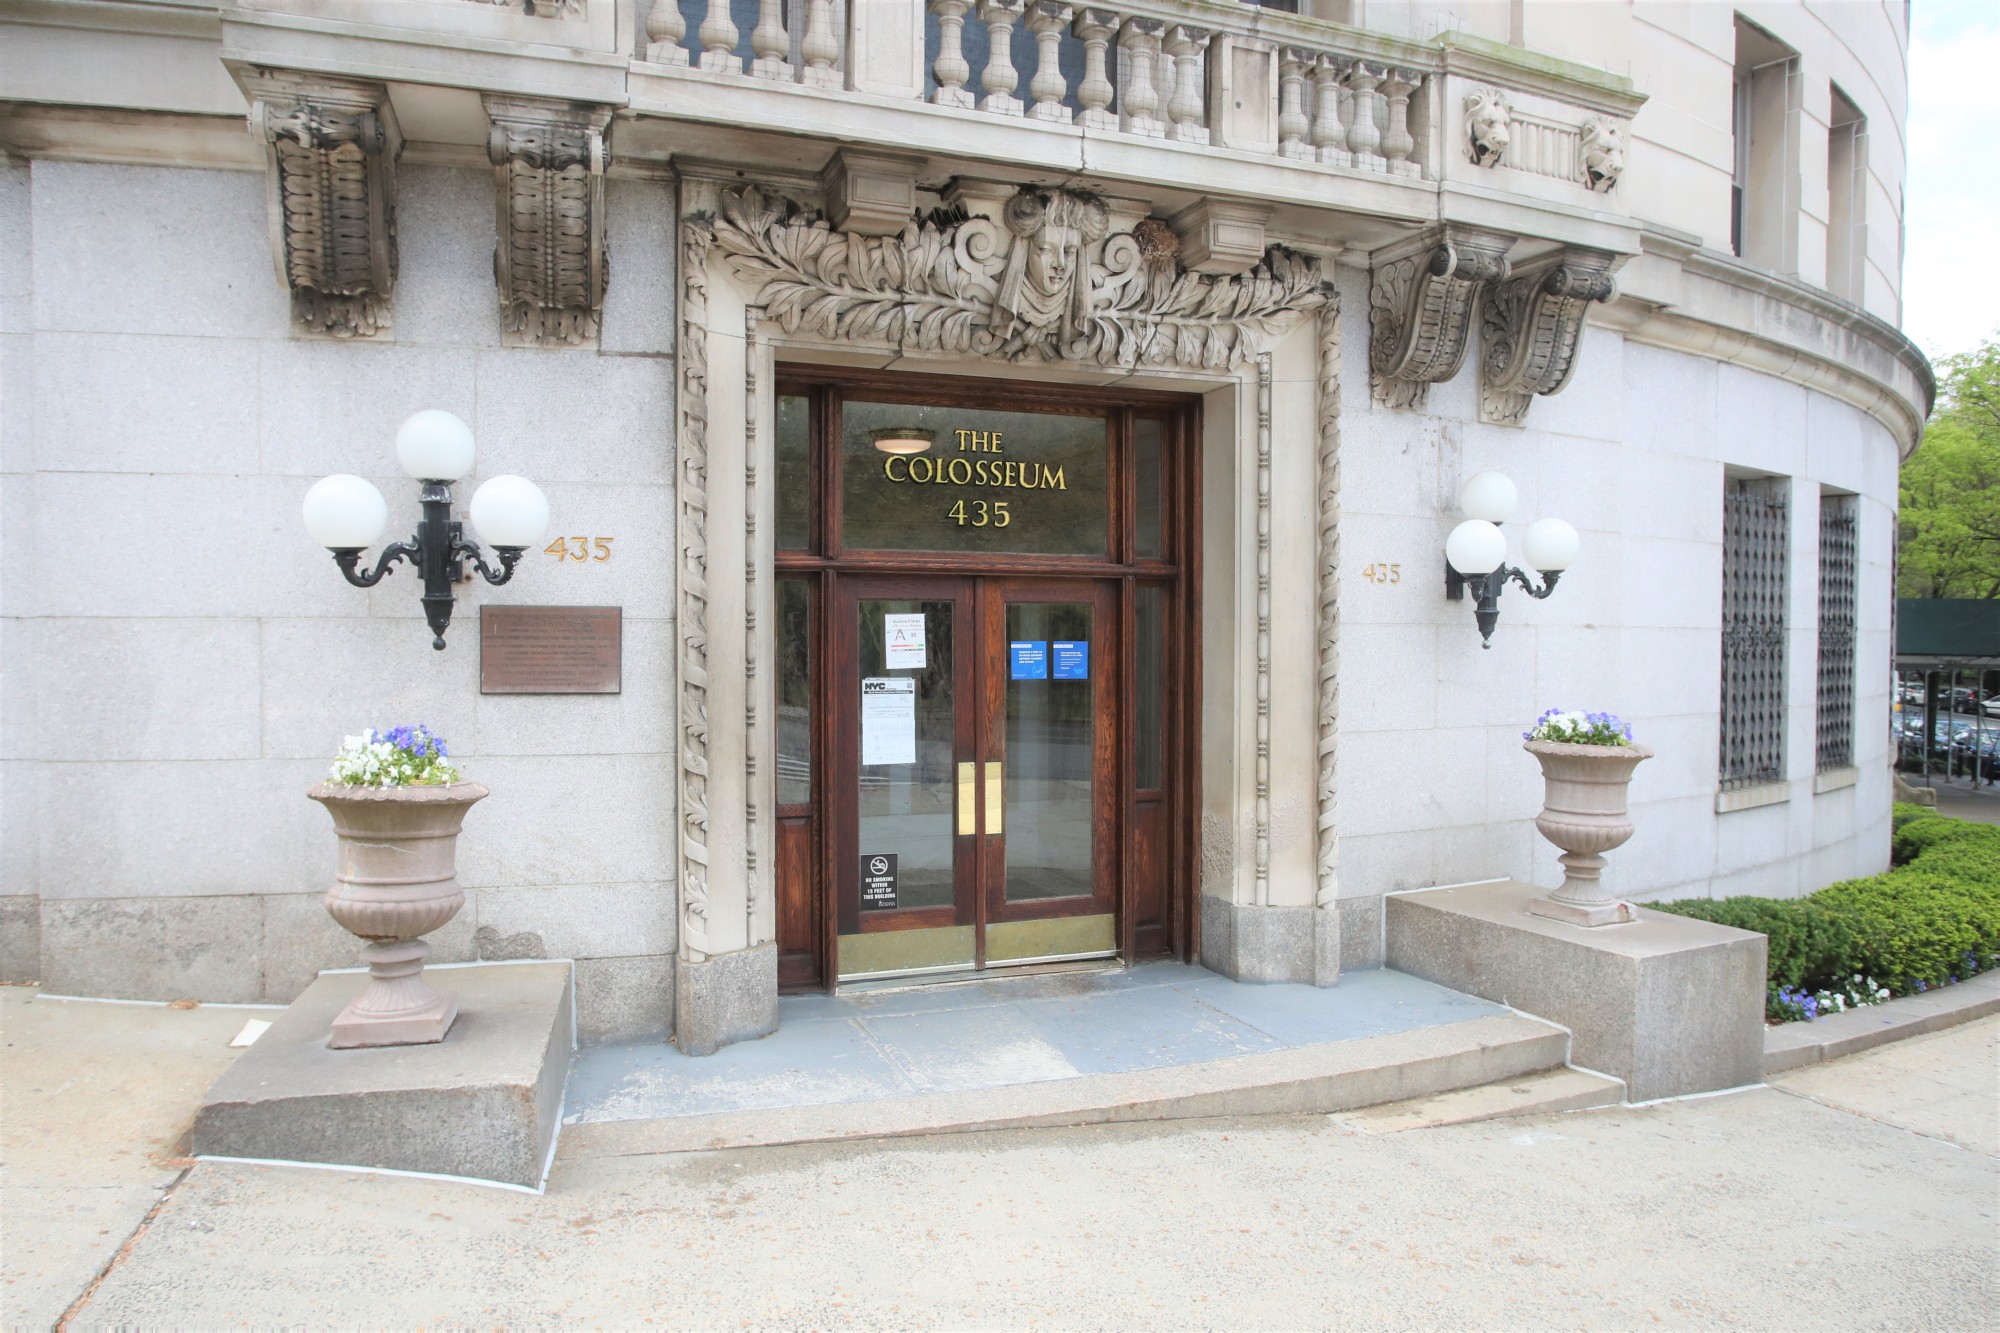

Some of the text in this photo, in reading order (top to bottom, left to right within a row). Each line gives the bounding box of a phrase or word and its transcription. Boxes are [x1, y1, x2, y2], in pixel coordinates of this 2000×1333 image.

[954, 428, 1003, 453] THE
[884, 456, 1067, 490] COLOSSEUM
[948, 500, 1011, 528] 435
[543, 536, 614, 563] 435
[1362, 563, 1401, 584] 435
[895, 628, 906, 641] A
